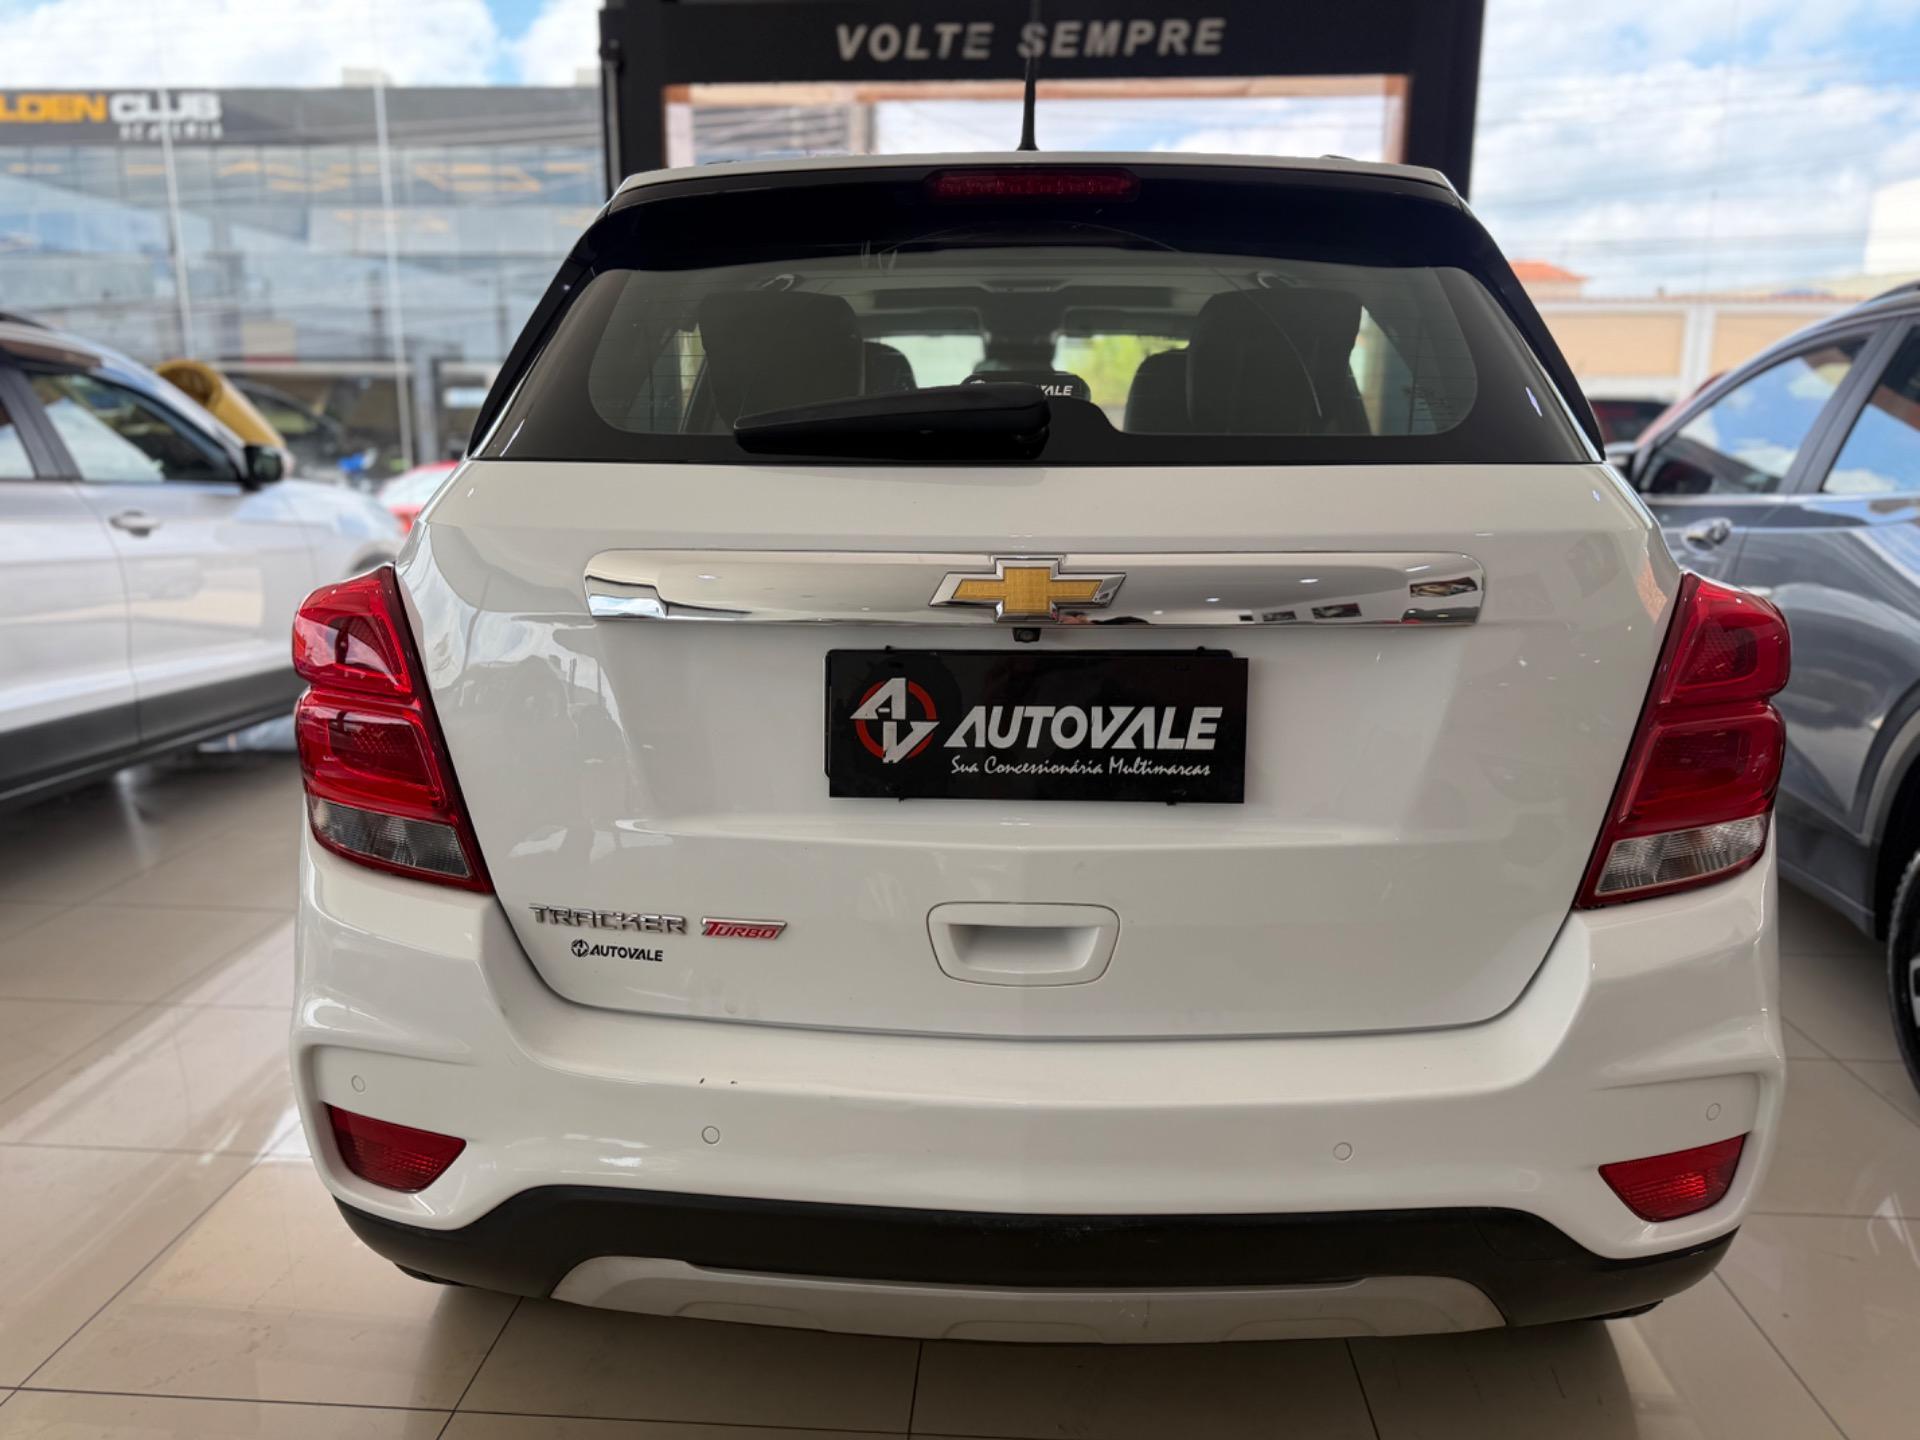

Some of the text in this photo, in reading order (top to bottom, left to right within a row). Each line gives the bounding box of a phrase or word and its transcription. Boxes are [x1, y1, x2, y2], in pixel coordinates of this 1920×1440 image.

[836, 18, 1227, 61] VOLTE SEMPRE
[943, 705, 1223, 751] AUTOVALE
[951, 755, 1212, 777] Sua Concessionária Multimarcas
[529, 903, 687, 934] TRACKER
[590, 944, 664, 962] AUTOVALE
